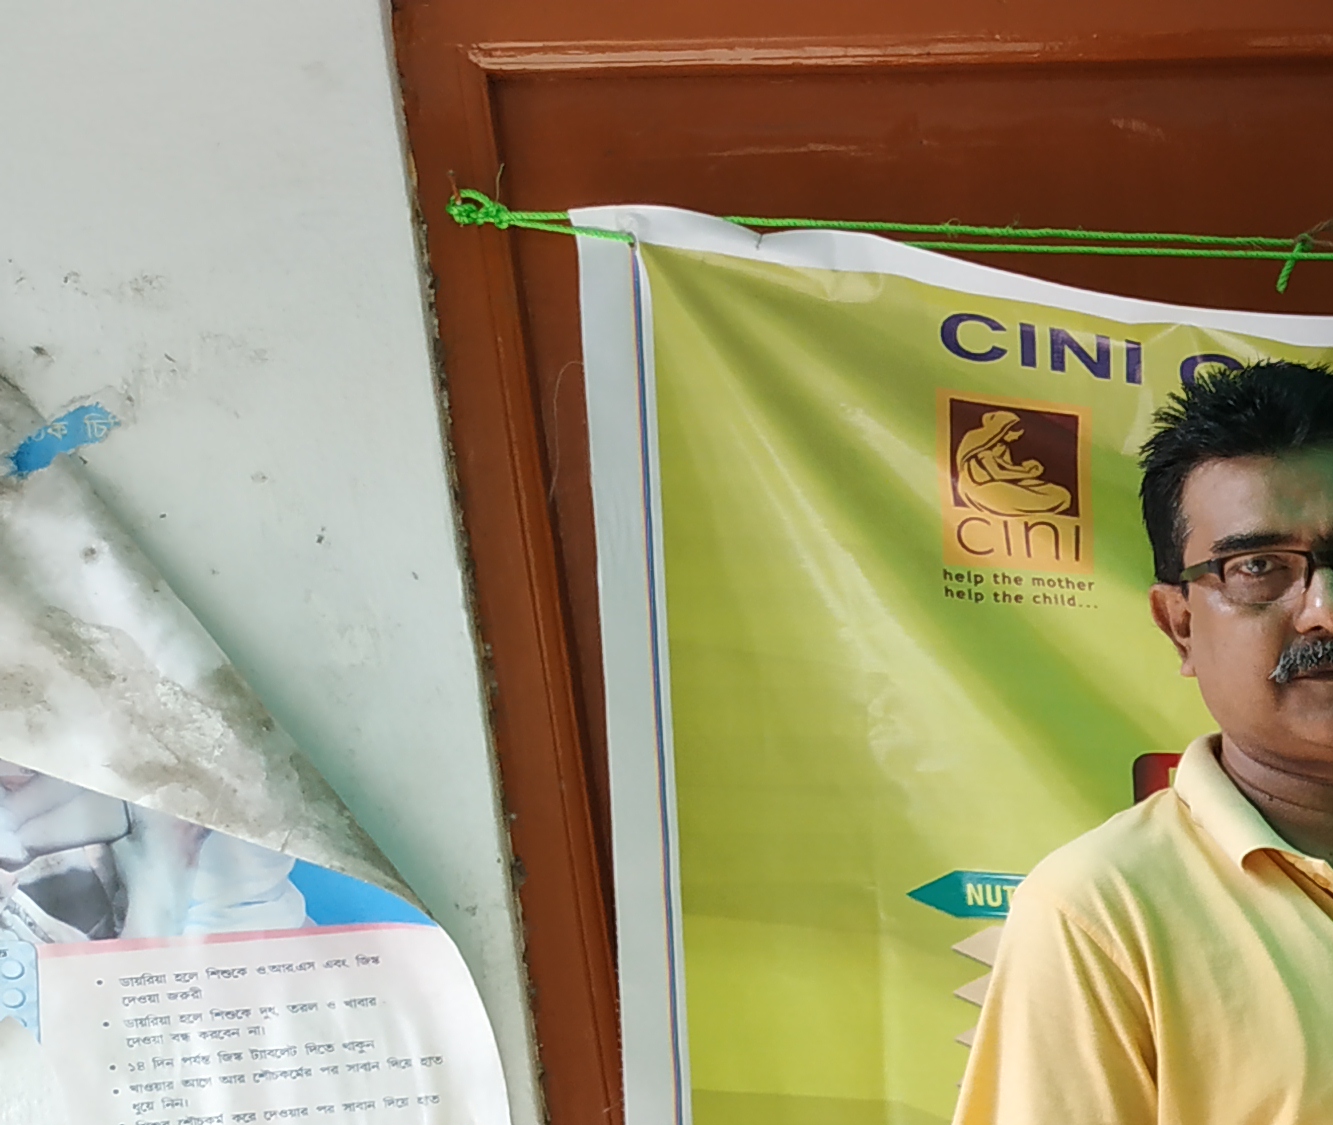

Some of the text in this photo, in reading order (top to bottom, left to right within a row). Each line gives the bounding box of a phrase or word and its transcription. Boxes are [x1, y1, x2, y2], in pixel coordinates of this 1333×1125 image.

[940, 312, 1142, 385] CINI
[942, 568, 1095, 591] help the mother
[944, 586, 985, 604] help
[993, 591, 1024, 604] the
[966, 883, 1017, 908] NUT
